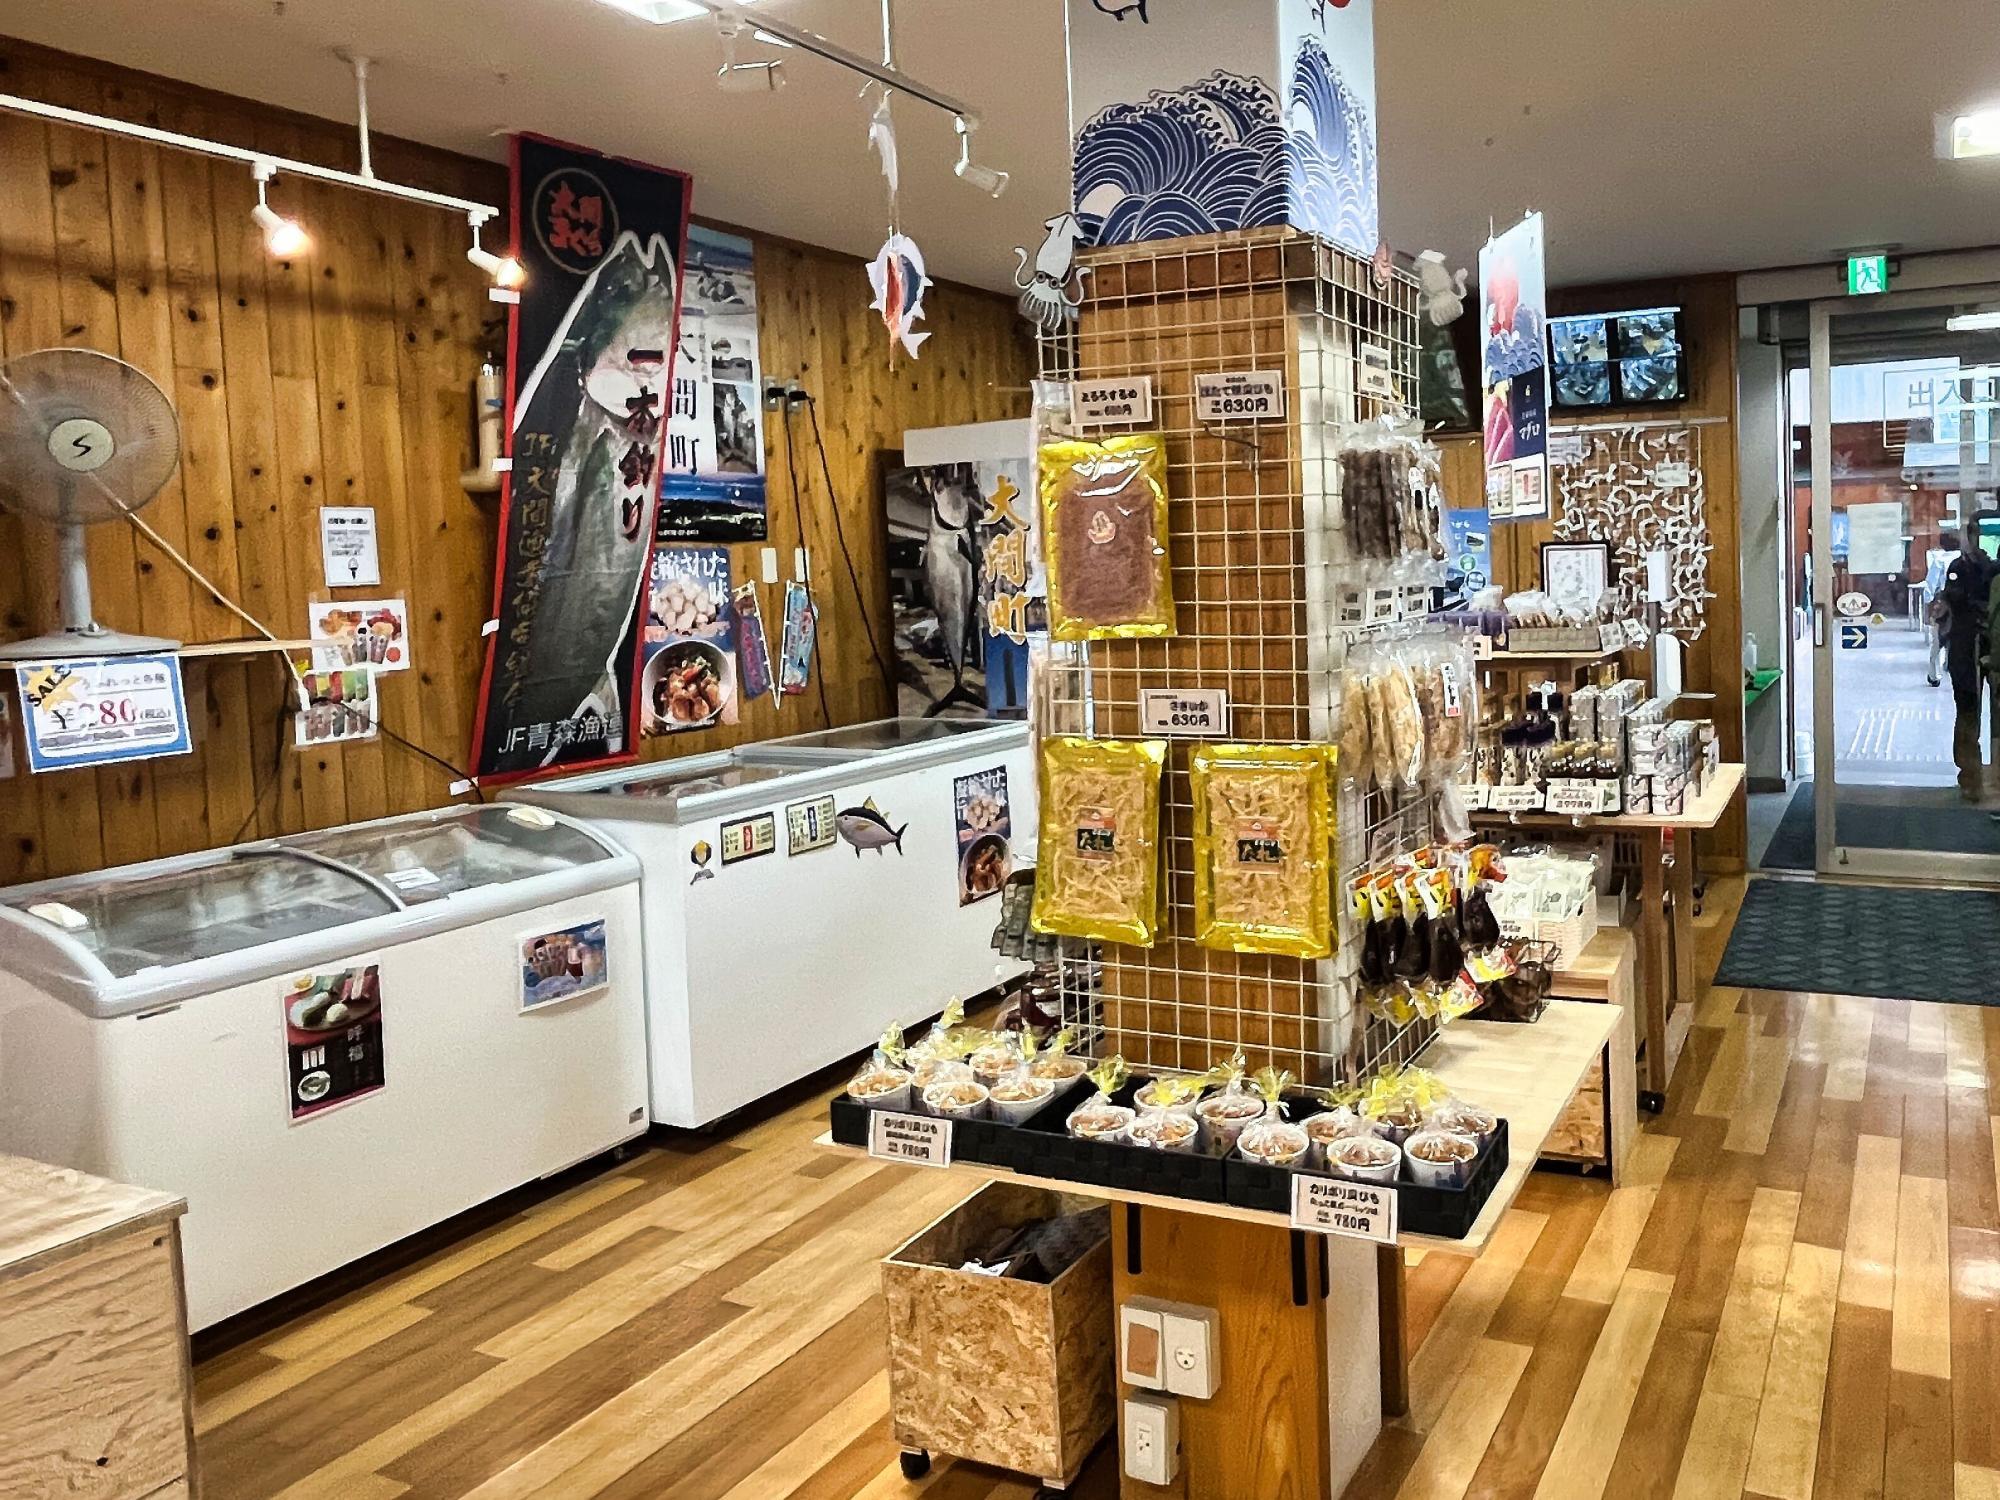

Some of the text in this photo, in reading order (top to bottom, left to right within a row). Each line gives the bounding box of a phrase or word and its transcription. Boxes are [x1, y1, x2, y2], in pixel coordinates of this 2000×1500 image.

[1223, 397, 1268, 413] 630円
[979, 474, 1032, 646] 大間町
[1171, 713, 1210, 727] 630円
[1334, 1213, 1370, 1232] 780円
